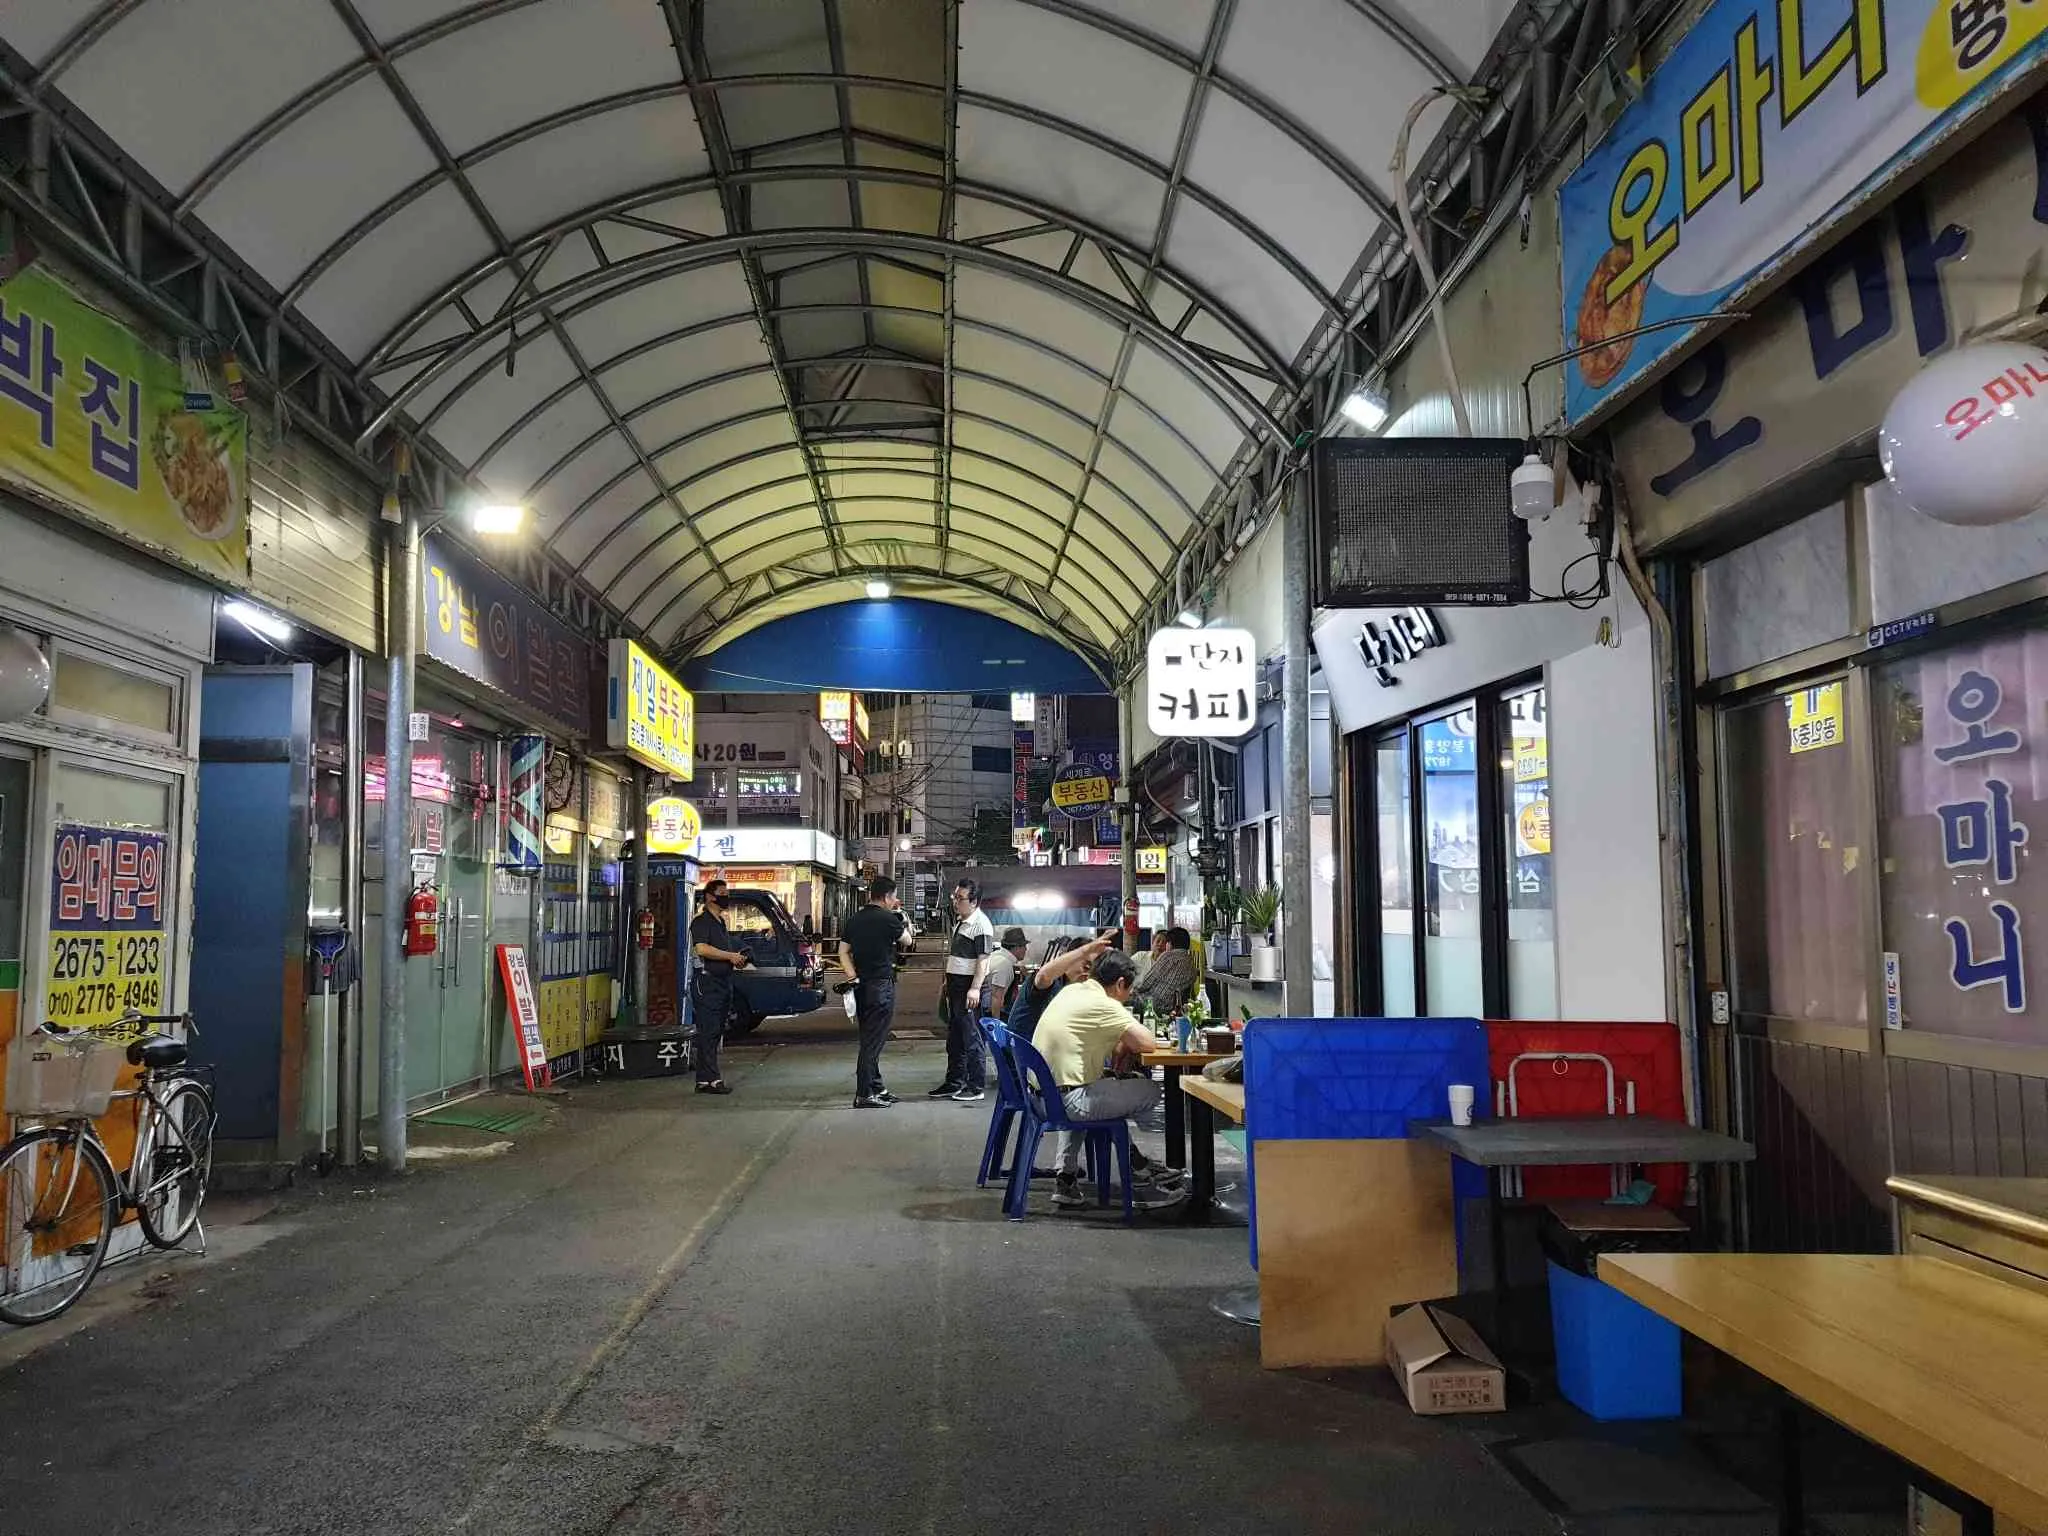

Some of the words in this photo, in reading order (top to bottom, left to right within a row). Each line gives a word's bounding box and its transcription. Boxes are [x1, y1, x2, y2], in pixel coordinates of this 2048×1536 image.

[1607, 0, 1888, 304] 오마니
[431, 565, 479, 649] 강남
[1158, 687, 1249, 721] 커피
[1058, 780, 1105, 803] 부동산
[1933, 670, 2029, 1013] 오마니
[57, 834, 163, 922] 임대문의
[654, 865, 683, 876] ATM
[53, 936, 160, 979] 2675-1233
[75, 980, 159, 1015] 2776-4949
[513, 968, 534, 1021] 이발
